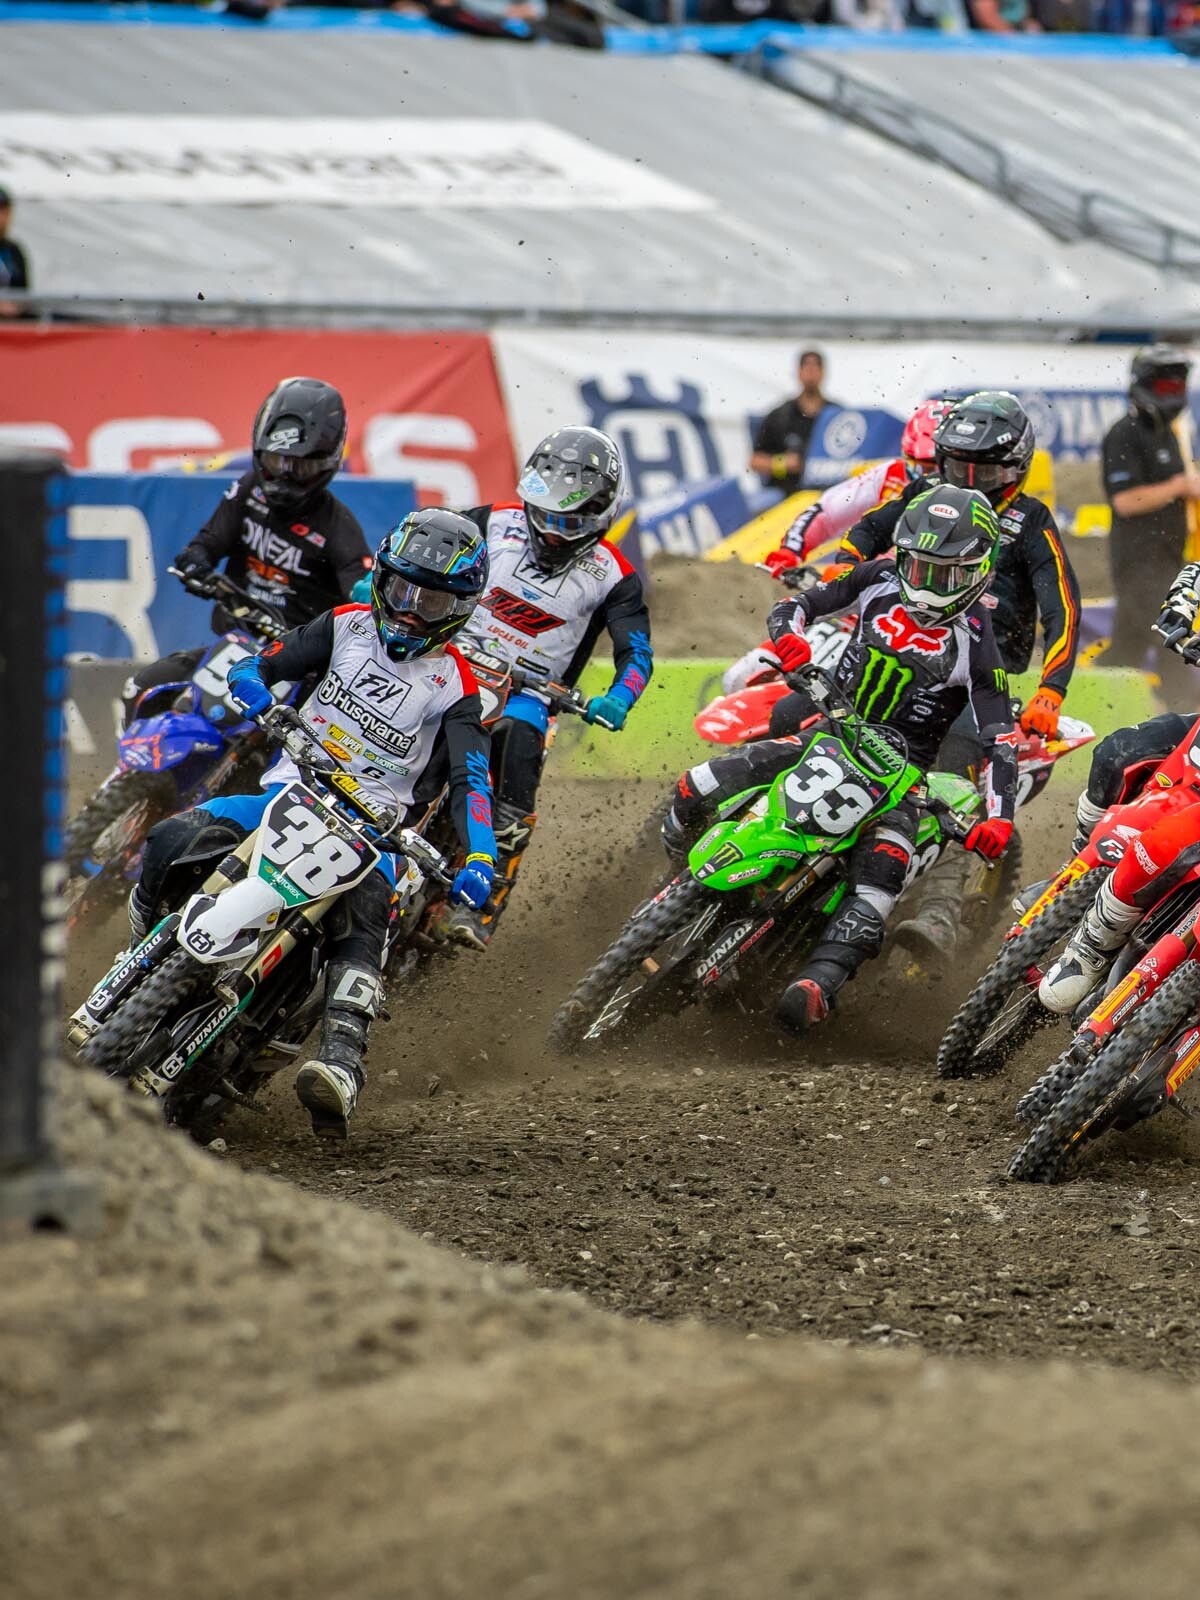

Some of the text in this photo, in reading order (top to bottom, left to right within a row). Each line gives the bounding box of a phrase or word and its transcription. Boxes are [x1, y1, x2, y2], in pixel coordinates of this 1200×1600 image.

[932, 506, 955, 517] BELL
[407, 542, 447, 564] FLY
[487, 624, 530, 651] LUCAS OIL
[355, 673, 404, 704] FLY
[1035, 695, 1059, 713] FLY
[333, 690, 414, 750] Husqvarna
[328, 724, 363, 755] PROTAPER
[363, 731, 388, 749] FACTORY
[373, 757, 411, 776] MOTOREX
[843, 756, 871, 787] MONSTER
[783, 755, 875, 835] 33
[262, 804, 362, 898] 38
[873, 843, 910, 866] FOX
[111, 930, 164, 990] DUNLOP
